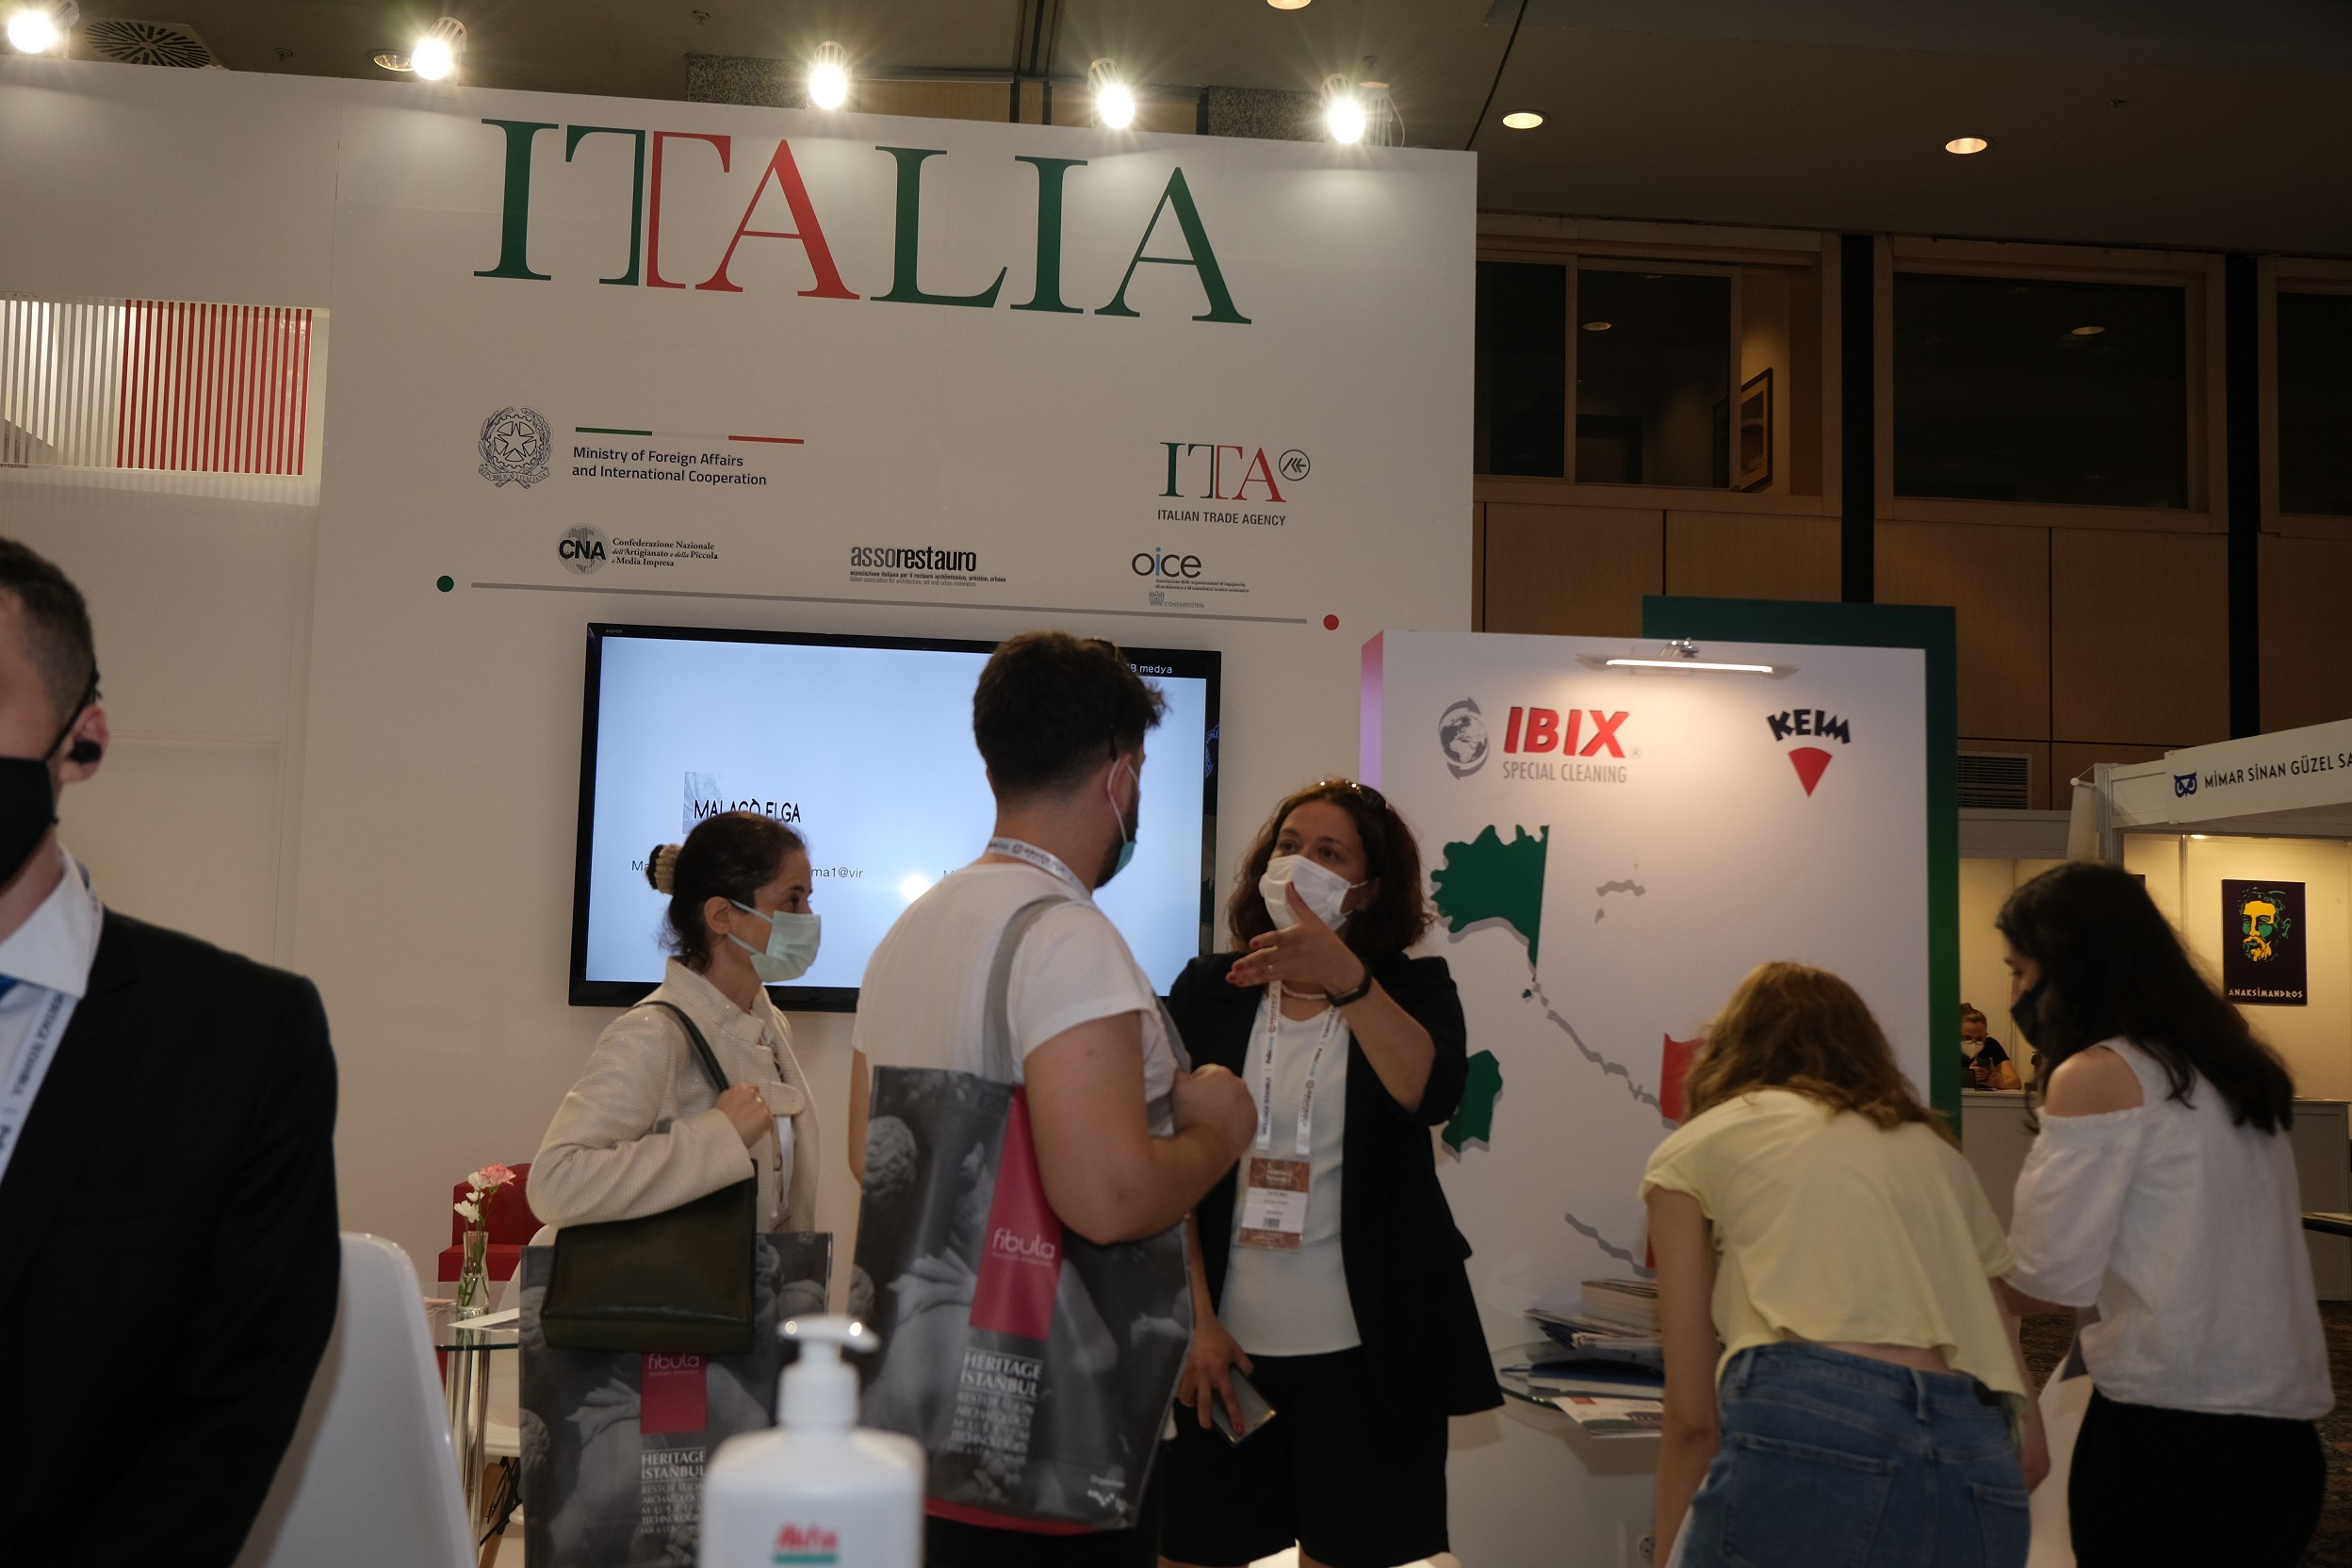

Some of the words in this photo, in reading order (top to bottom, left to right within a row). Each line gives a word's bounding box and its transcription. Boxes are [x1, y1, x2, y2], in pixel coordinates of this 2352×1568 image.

[474, 118, 1252, 325] ITALIA
[573, 447, 628, 464] Ministry
[630, 449, 645, 462] of
[648, 450, 696, 467] Foreign
[700, 452, 743, 466] Affairs
[572, 465, 596, 477] and
[600, 466, 685, 482] International
[689, 470, 767, 488] Cooperation
[1158, 442, 1286, 502] ITA
[1157, 510, 1200, 522] ITALIAN
[1203, 512, 1238, 524] TRADE
[1242, 514, 1286, 526] AGENCY
[559, 539, 606, 561] CNA
[612, 537, 675, 548] Confederazione
[676, 541, 714, 550] Nazionale
[616, 557, 641, 565] Media
[643, 558, 675, 567] Impresa
[690, 551, 718, 560] Piccola
[850, 546, 977, 572] assorestauro
[1131, 547, 1202, 579] oice
[1140, 665, 1172, 675] medya
[1503, 707, 1630, 759] IBIX
[1767, 709, 1851, 744] KEIM
[1502, 760, 1557, 780] SPECIAL
[1560, 763, 1627, 784] CLEANING
[2204, 769, 2245, 789] MİMAR
[2248, 762, 2286, 782] SİNAN
[2291, 755, 2334, 776] GÜZEL
[2229, 988, 2303, 999] ANAKSİMANDROS
[991, 1227, 1055, 1260] fibula
[648, 1353, 699, 1370] fibula
[963, 1352, 1043, 1381] HERITAGE
[641, 1450, 706, 1466] HERITAGE
